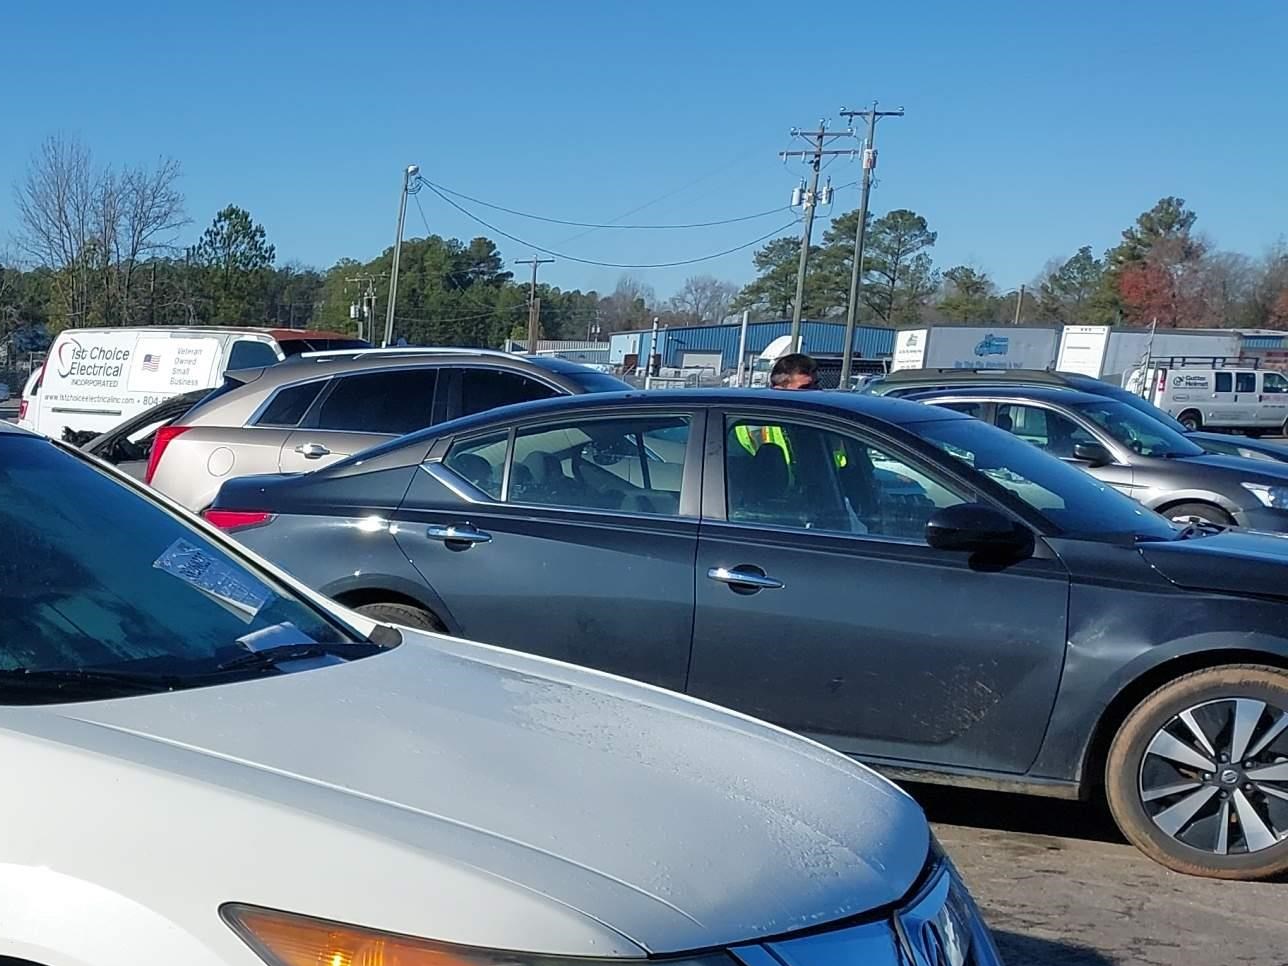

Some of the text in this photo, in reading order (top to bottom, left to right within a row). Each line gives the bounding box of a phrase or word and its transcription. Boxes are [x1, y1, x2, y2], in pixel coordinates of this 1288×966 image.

[71, 346, 130, 361] 1st Choice
[177, 347, 203, 356] Veteran
[174, 357, 198, 366] Owned
[69, 361, 124, 377] Electrical
[172, 367, 190, 376] Small
[71, 378, 119, 388] INCORPORATED
[169, 376, 199, 386] Business
